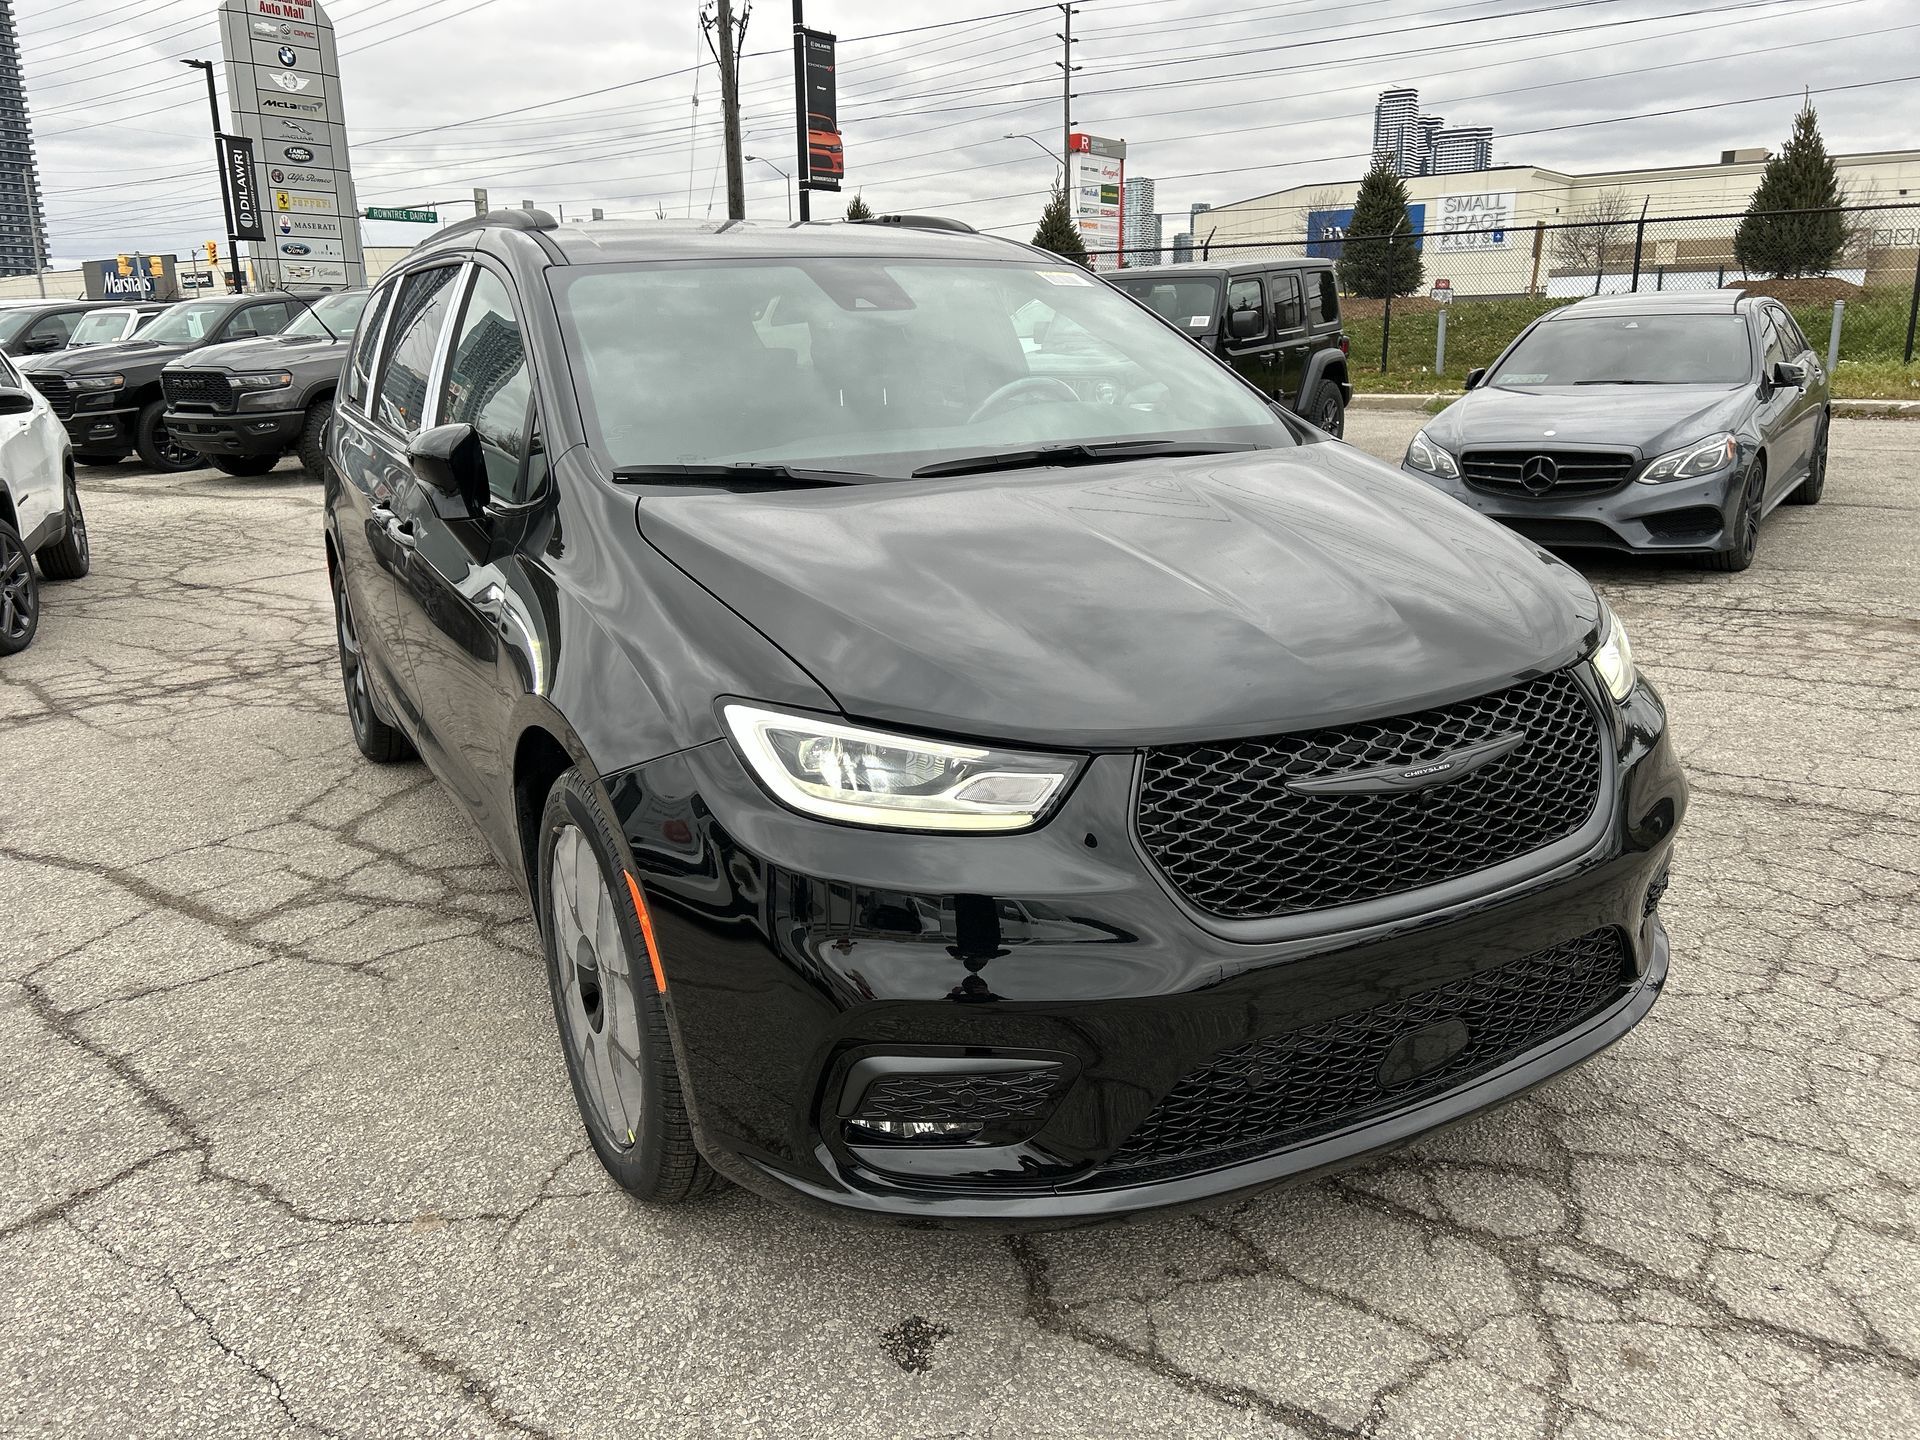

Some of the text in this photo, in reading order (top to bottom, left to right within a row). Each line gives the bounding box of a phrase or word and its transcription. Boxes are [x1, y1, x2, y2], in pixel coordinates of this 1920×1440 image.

[259, 0, 305, 20] Auto Mall
[293, 29, 316, 39] GMC
[262, 99, 318, 112] McLaren
[1081, 136, 1089, 150] R
[233, 149, 250, 210] DILAWRI
[287, 172, 332, 184] Alfa Romeo
[1444, 195, 1506, 214] SMALL
[373, 208, 407, 220] ROWNTREE
[410, 211, 427, 220] DAIRY
[294, 221, 336, 231] MASERATI
[1442, 212, 1505, 231] SPACE
[286, 245, 305, 254] Ford
[1404, 763, 1450, 778] CHRYSLER
